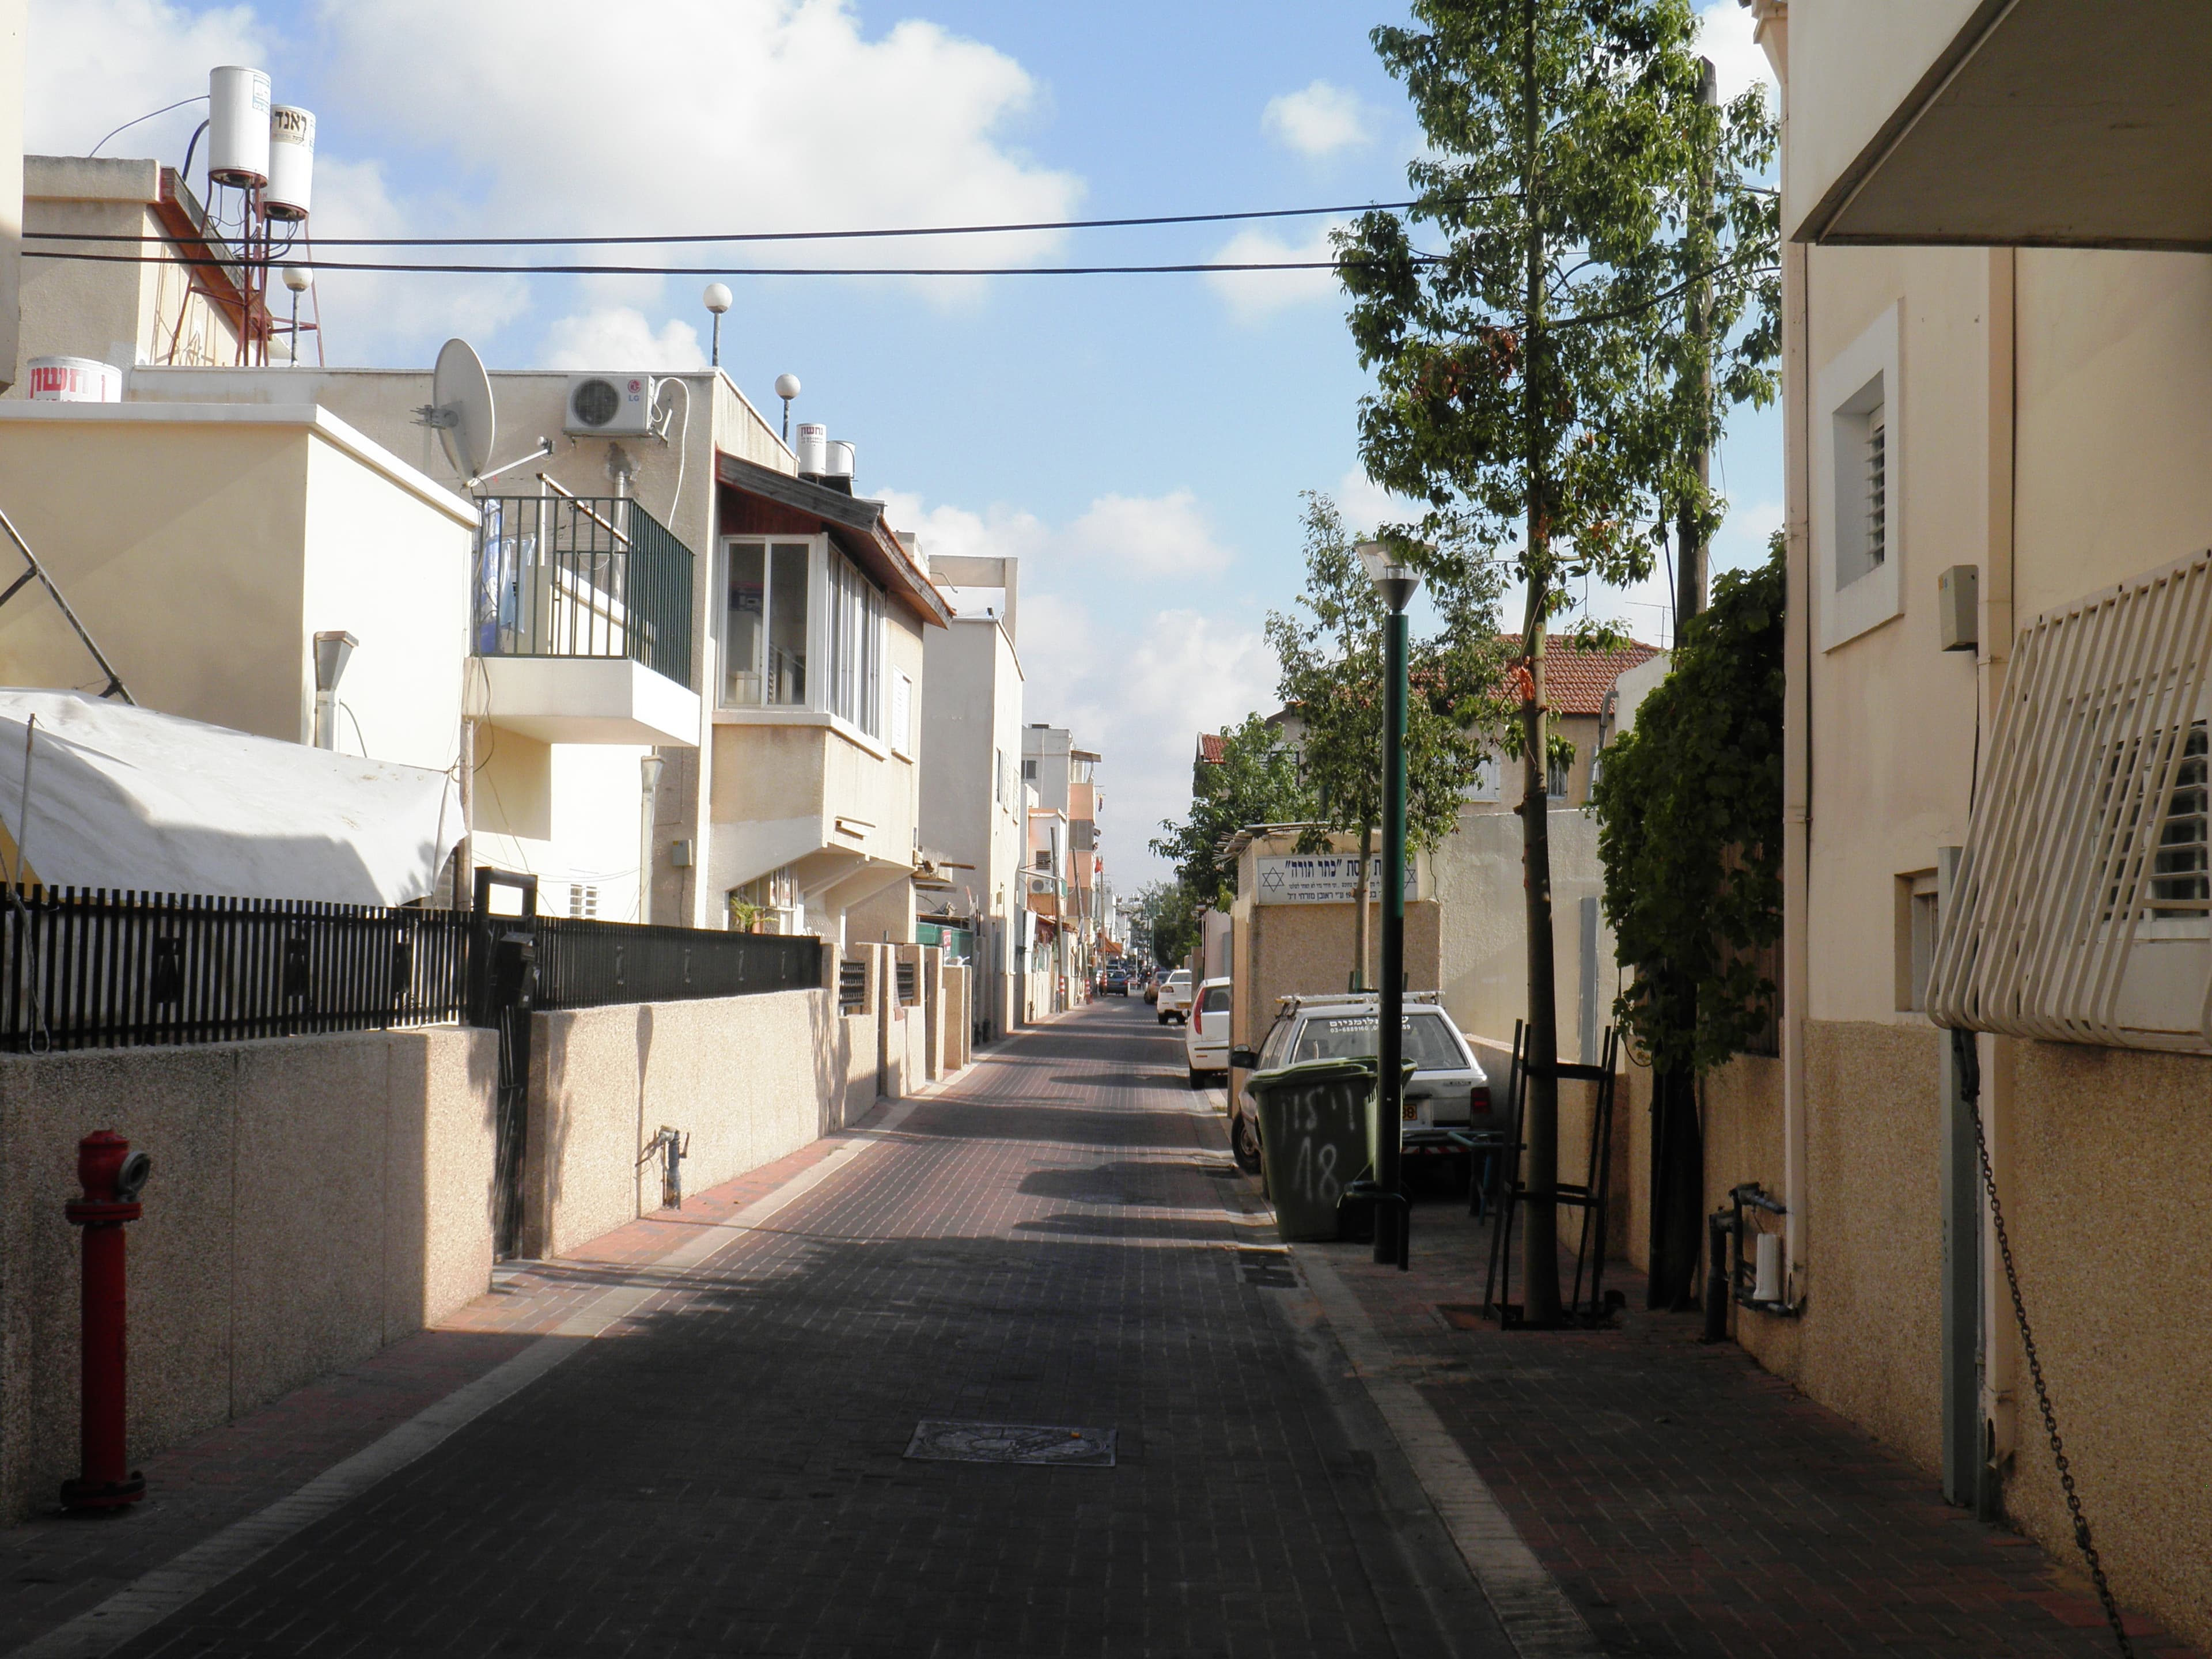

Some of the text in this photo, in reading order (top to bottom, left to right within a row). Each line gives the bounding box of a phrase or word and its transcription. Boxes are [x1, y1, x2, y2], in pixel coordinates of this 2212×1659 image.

[30, 367, 97, 399] חשון
[801, 426, 823, 437] נחשון
[1294, 1136, 1339, 1203] 18
